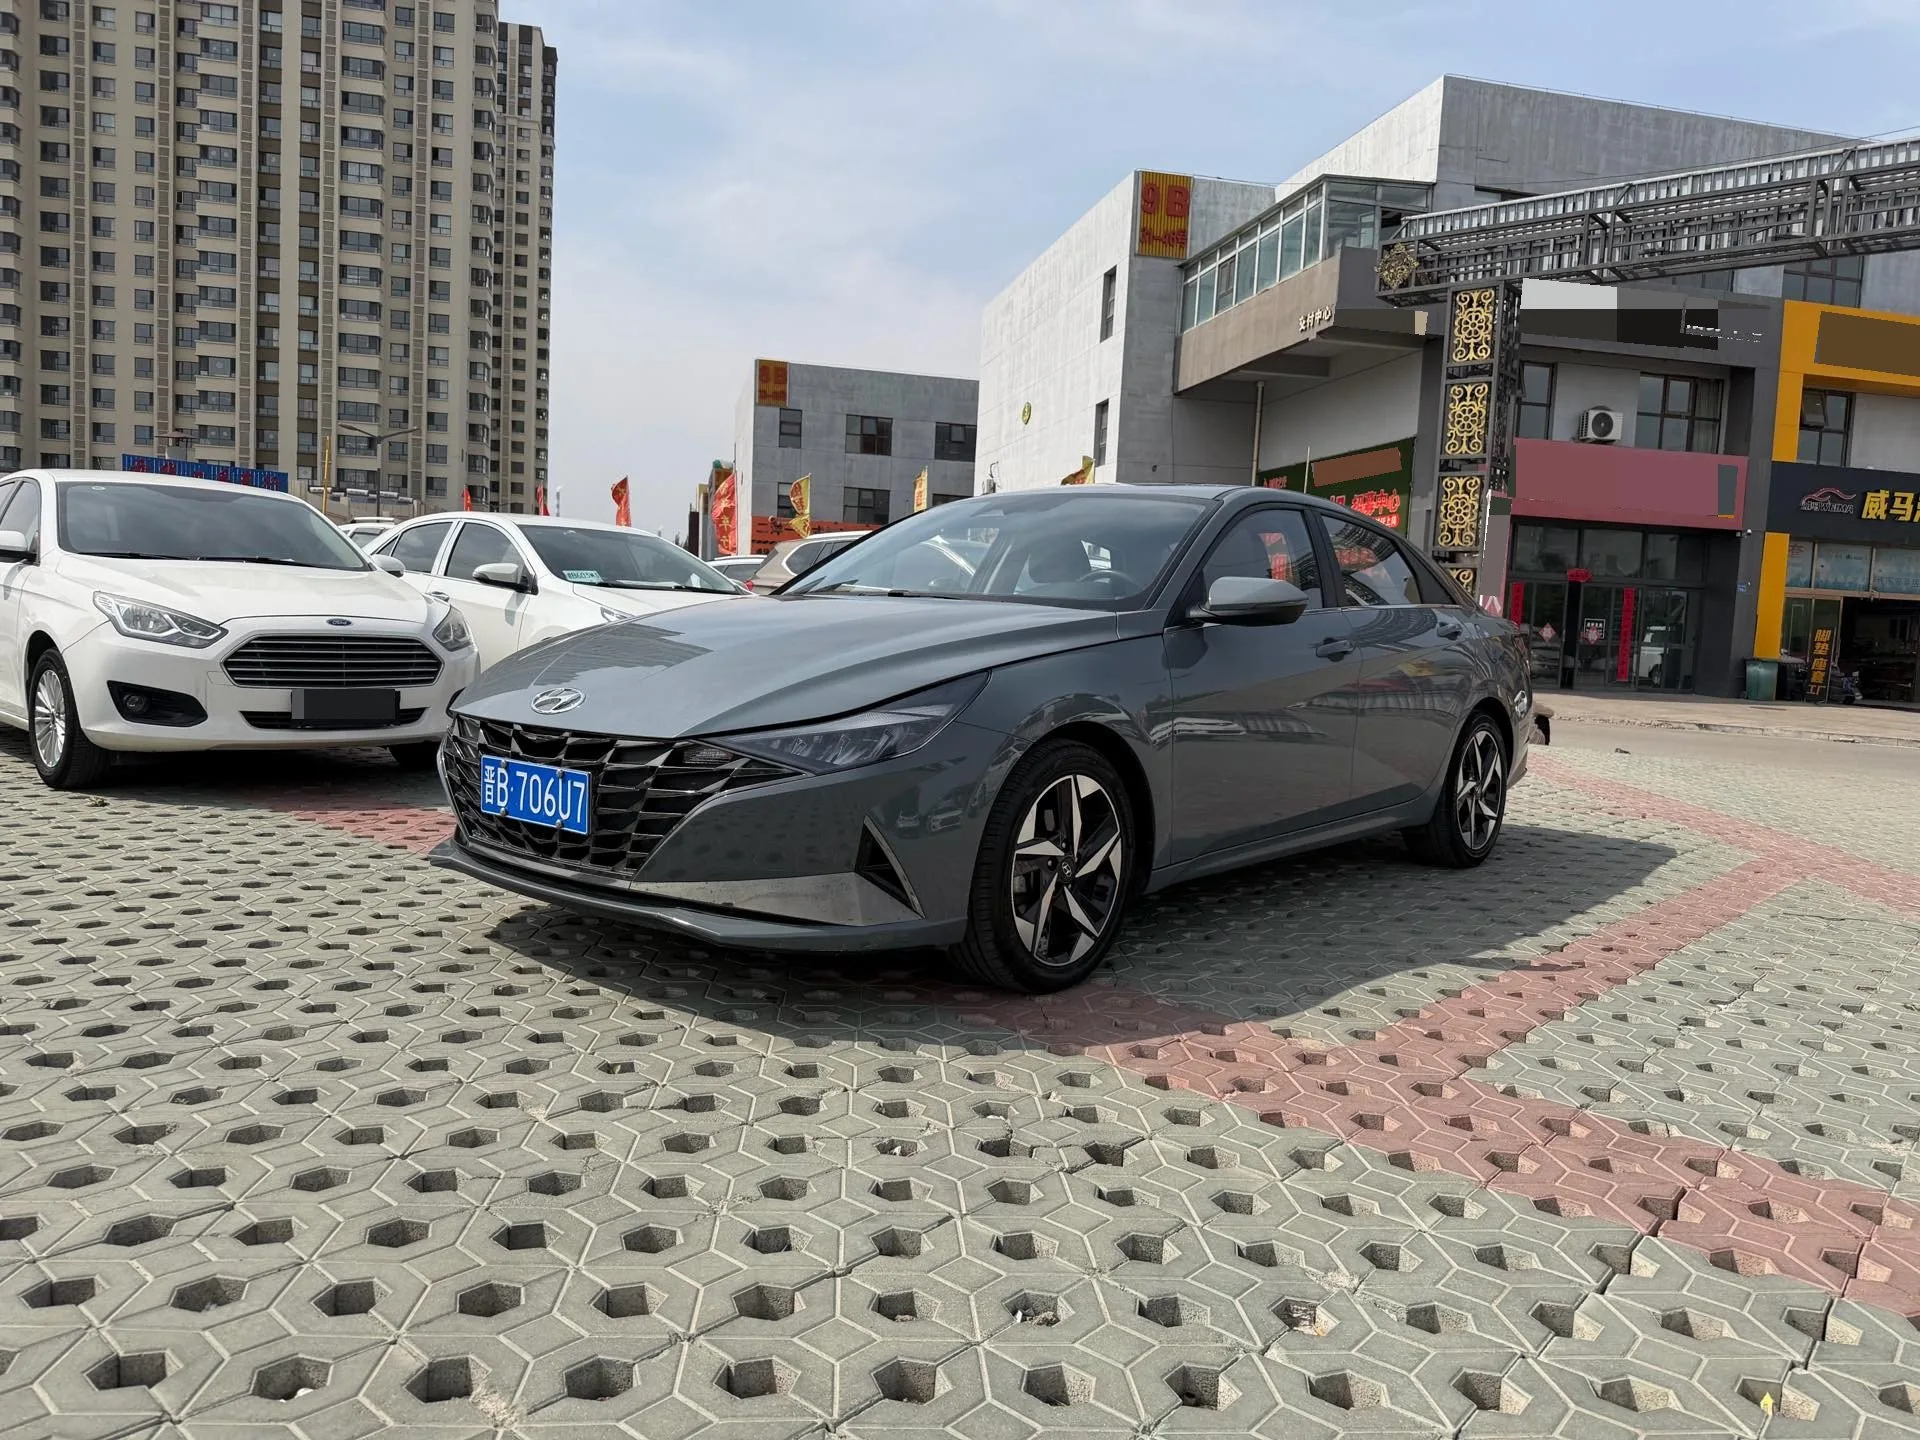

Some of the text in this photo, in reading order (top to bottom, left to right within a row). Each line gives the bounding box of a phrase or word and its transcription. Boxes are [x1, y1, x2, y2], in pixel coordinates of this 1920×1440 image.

[1299, 306, 1332, 332] 交付中心
[1861, 488, 1920, 523] 威马
